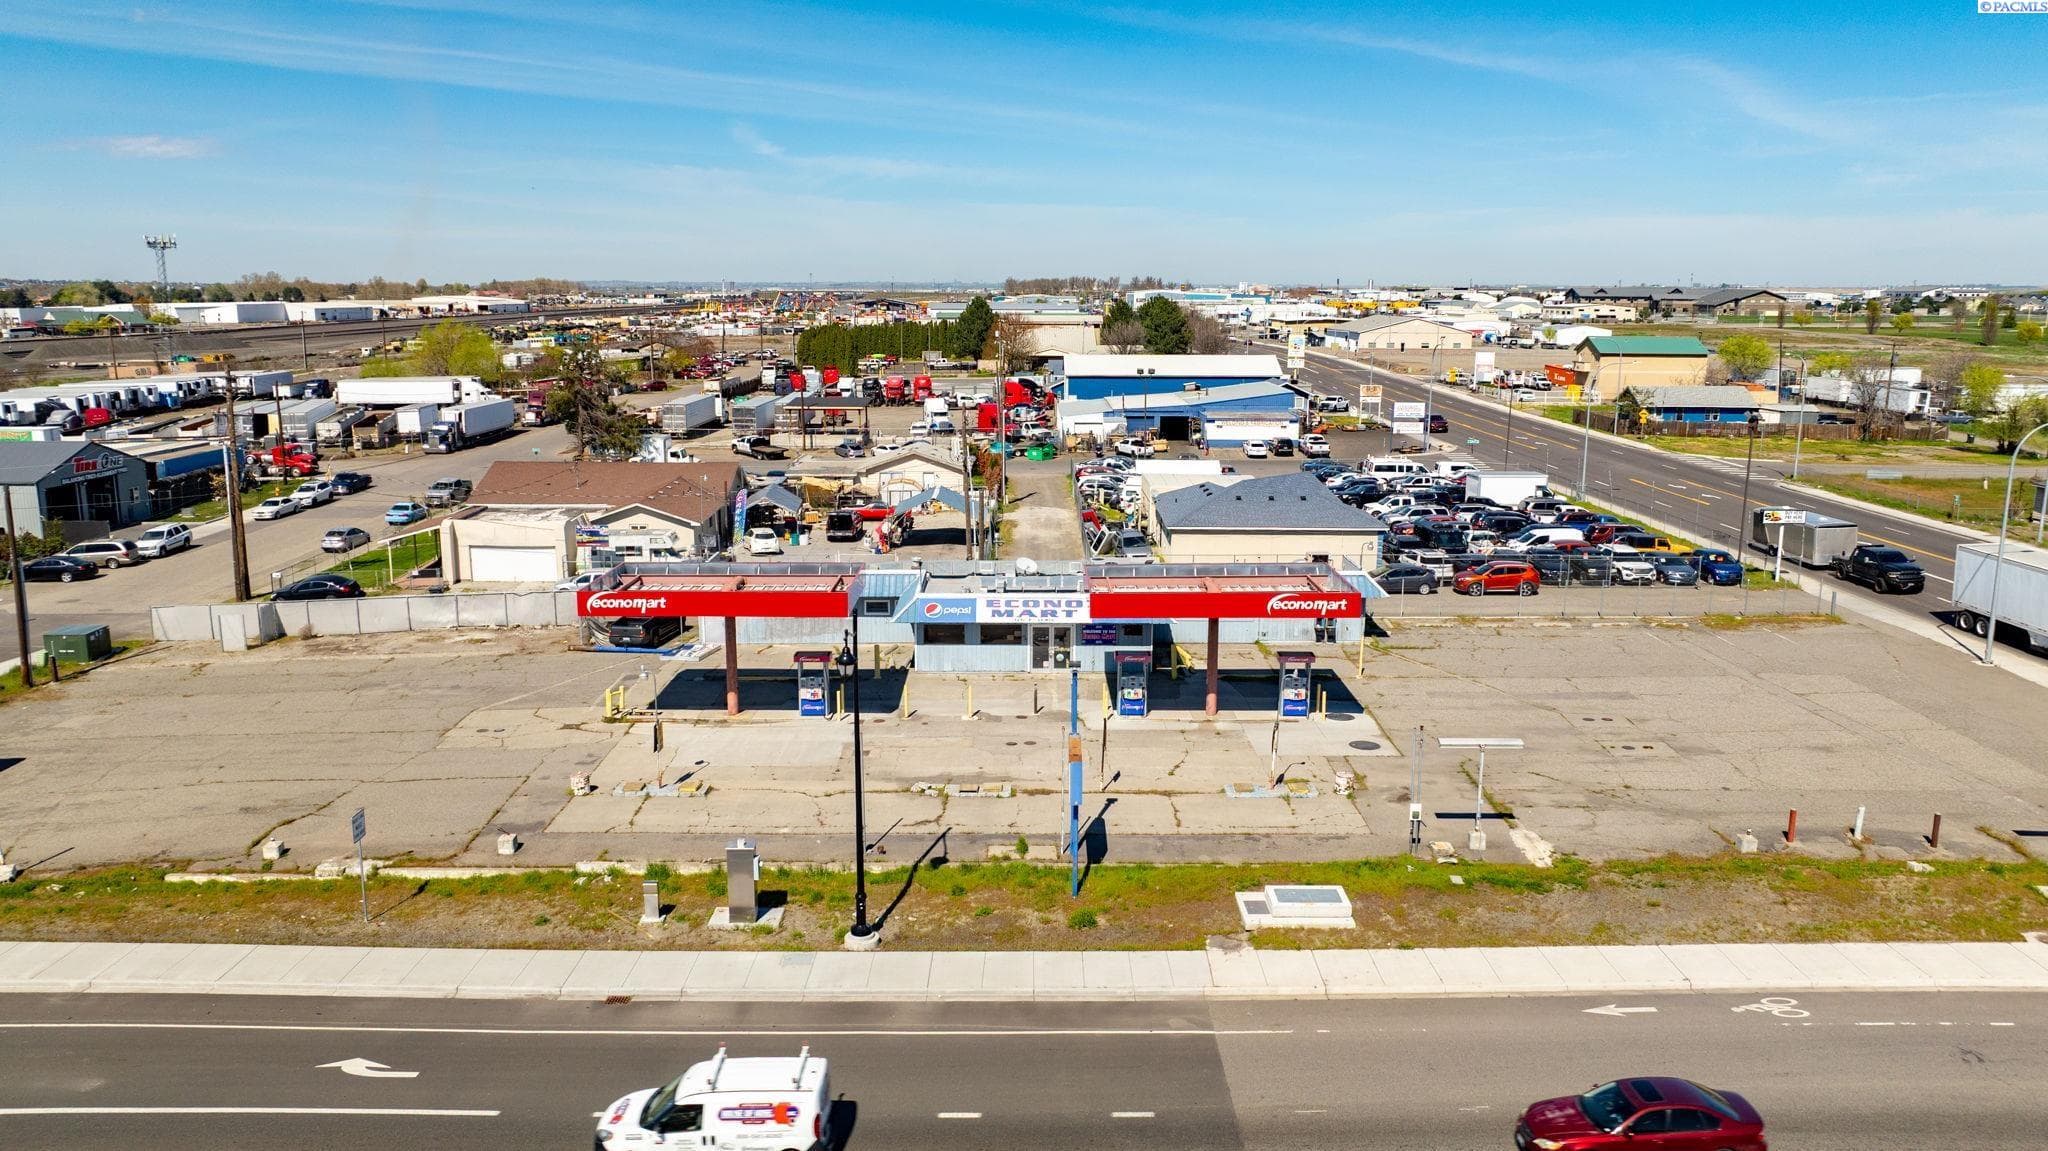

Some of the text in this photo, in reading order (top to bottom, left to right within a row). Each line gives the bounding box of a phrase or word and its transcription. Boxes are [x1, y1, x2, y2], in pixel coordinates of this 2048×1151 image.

[591, 596, 667, 614] economart
[986, 599, 1084, 608] ECONO
[1272, 598, 1348, 615] economart
[943, 606, 972, 615] pepsi
[991, 609, 1078, 618] MART
